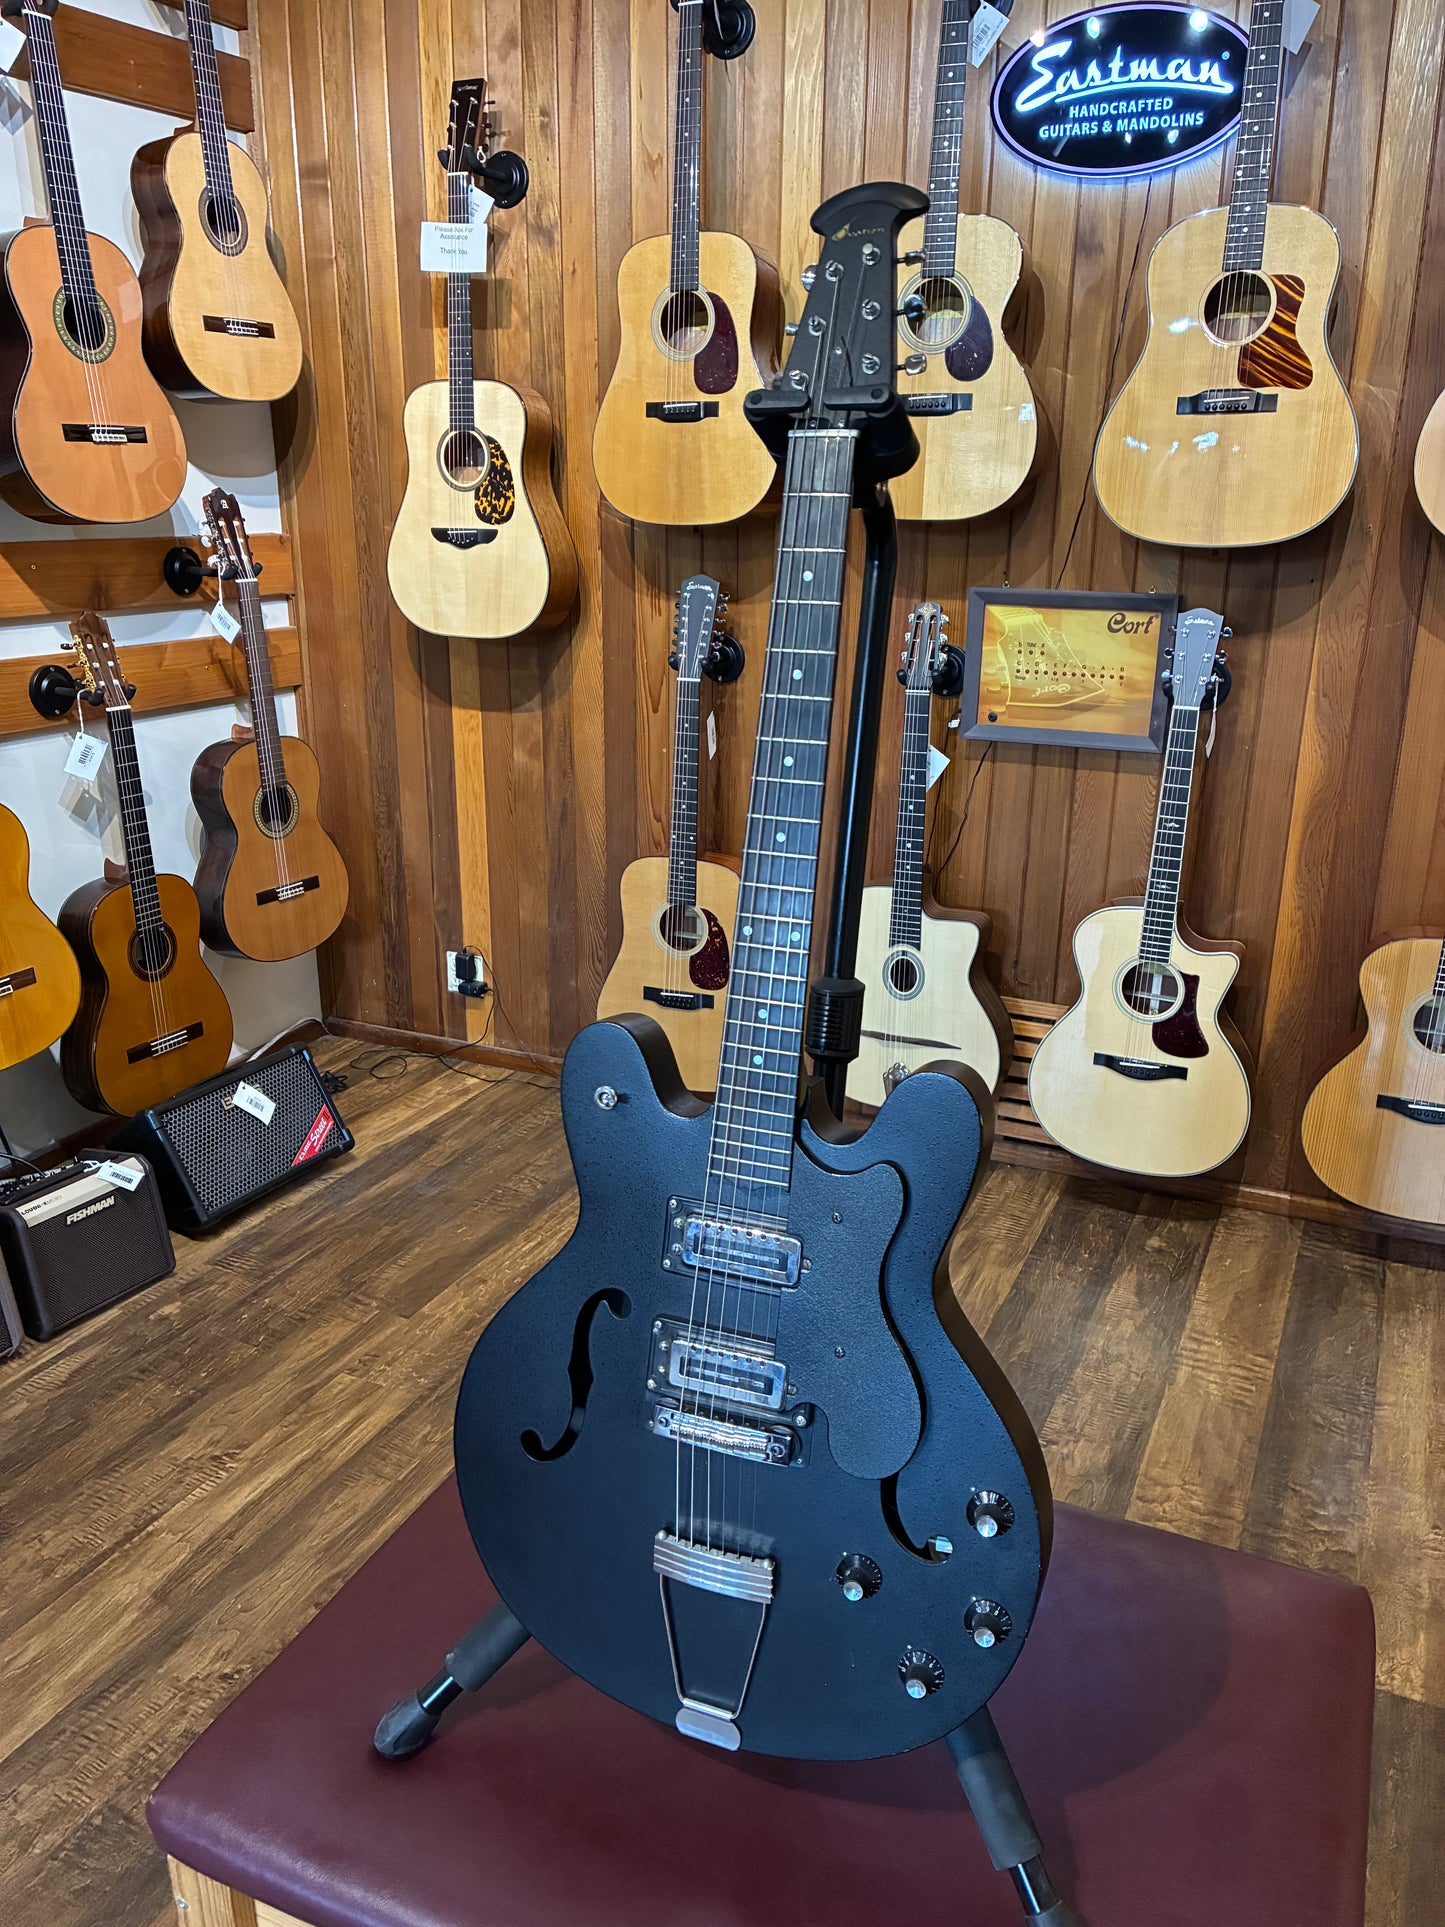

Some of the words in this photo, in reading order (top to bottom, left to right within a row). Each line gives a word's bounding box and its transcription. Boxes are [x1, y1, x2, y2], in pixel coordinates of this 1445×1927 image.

[1015, 39, 1234, 112] Eastman
[1069, 98, 1173, 118] HANDCRAFTED
[1039, 120, 1098, 138] GUITARS
[1101, 120, 1113, 133] &
[1116, 112, 1204, 133] MANDOLINS
[434, 225, 453, 233] Please
[457, 247, 468, 255] You
[1107, 612, 1156, 635] Cort
[66, 1195, 115, 1225] FISHMAN
